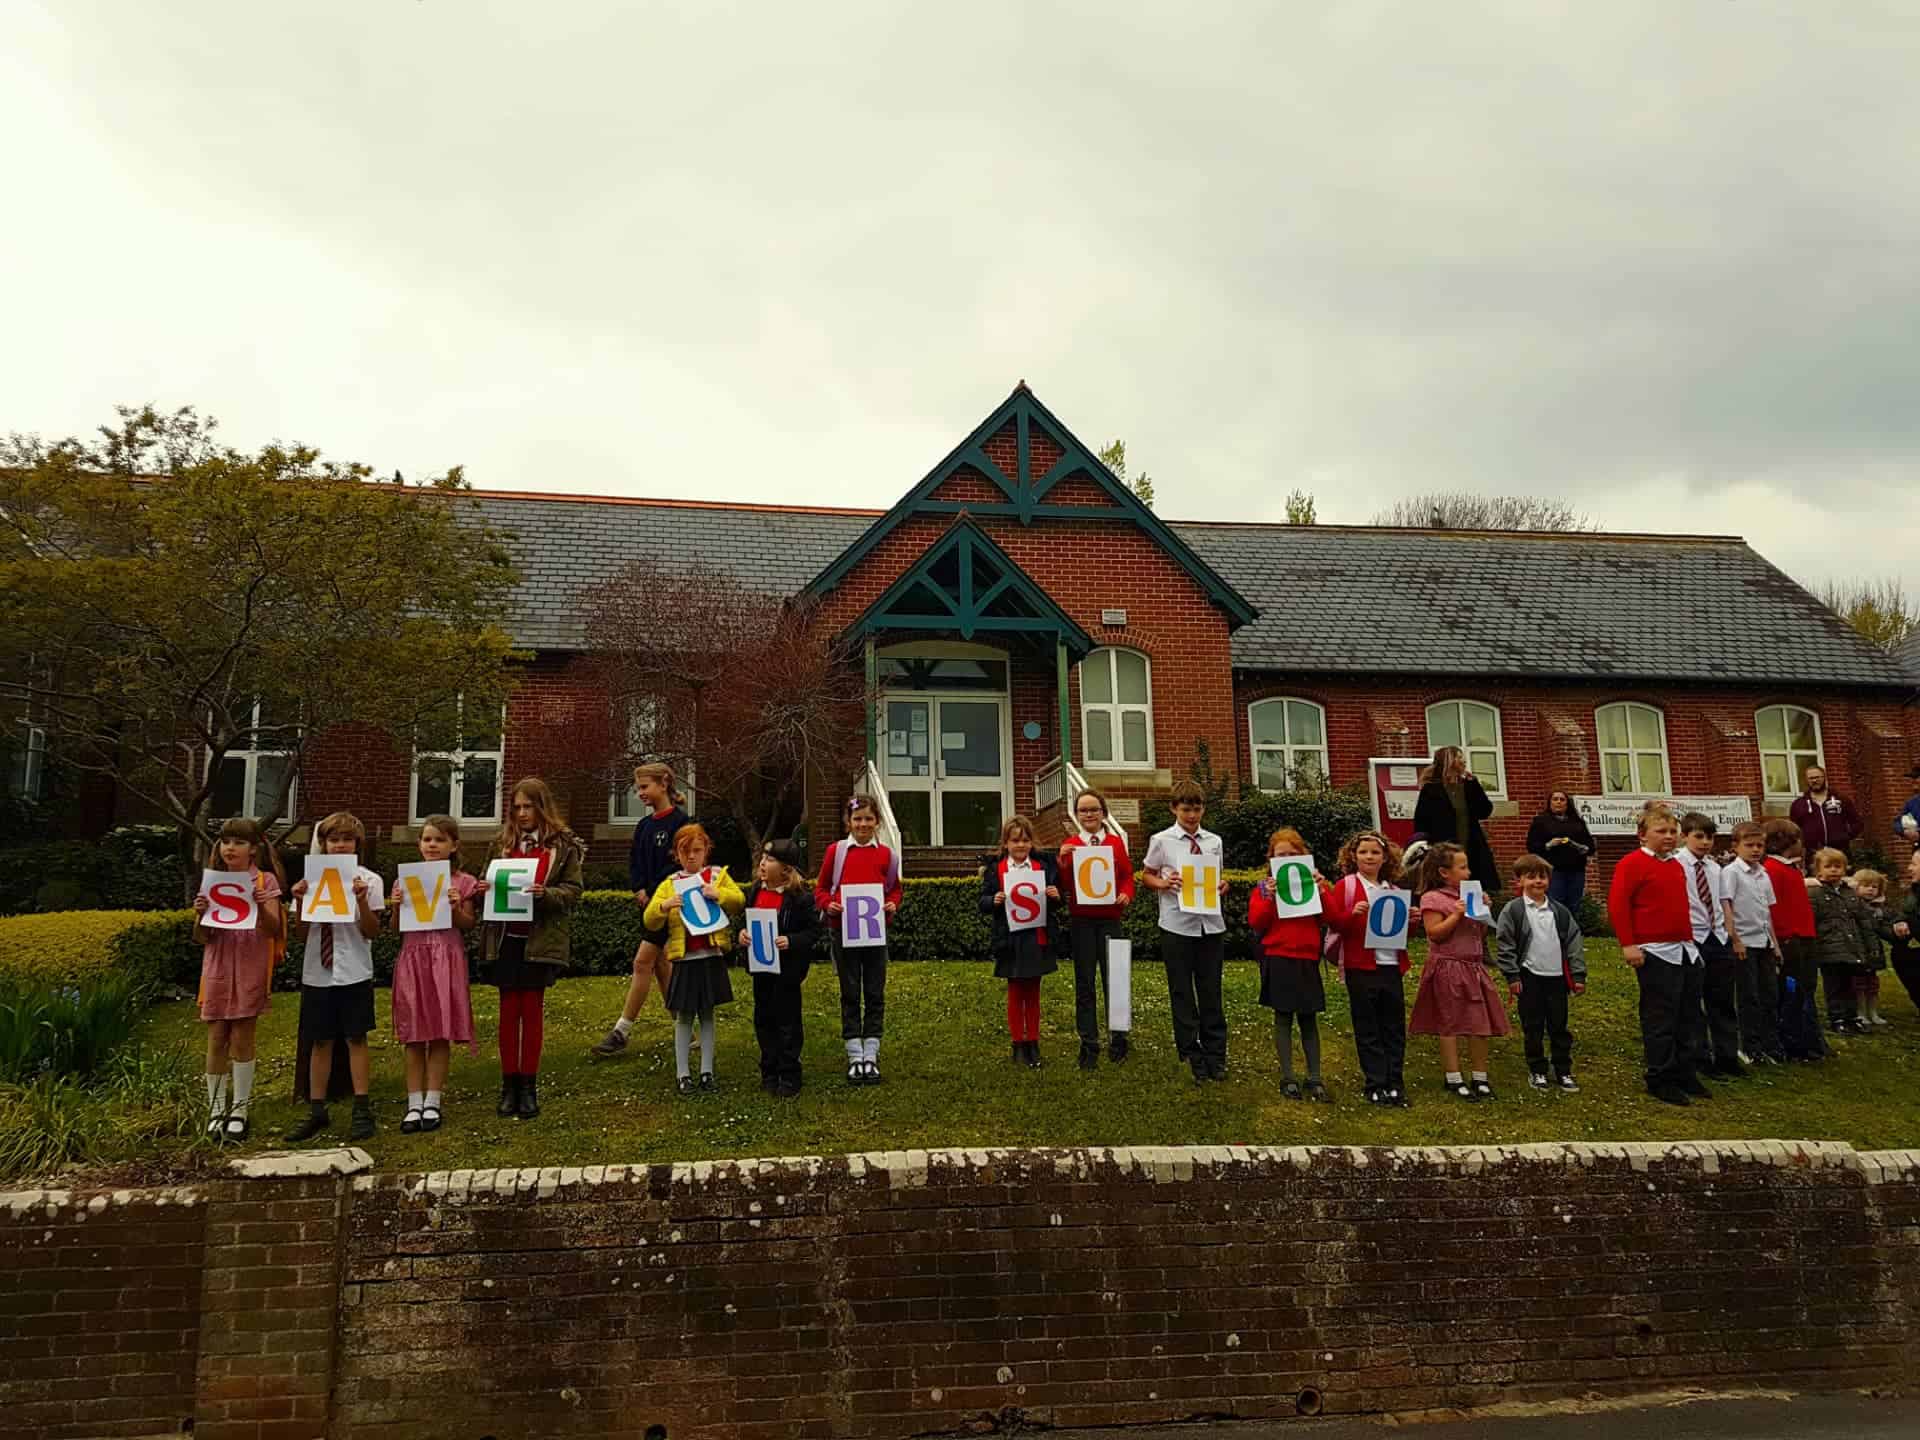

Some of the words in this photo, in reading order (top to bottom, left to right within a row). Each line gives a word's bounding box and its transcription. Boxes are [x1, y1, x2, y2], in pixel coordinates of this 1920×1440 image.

[307, 867, 350, 916] A
[403, 873, 445, 924] V
[493, 869, 528, 914] E
[1077, 856, 1113, 899] C
[1180, 865, 1217, 909] H
[1274, 862, 1315, 906] O
[209, 882, 251, 925] S
[681, 885, 722, 929] O
[846, 895, 883, 940] R
[1010, 882, 1042, 924] S
[1369, 895, 1408, 938] O
[751, 920, 775, 966] U
